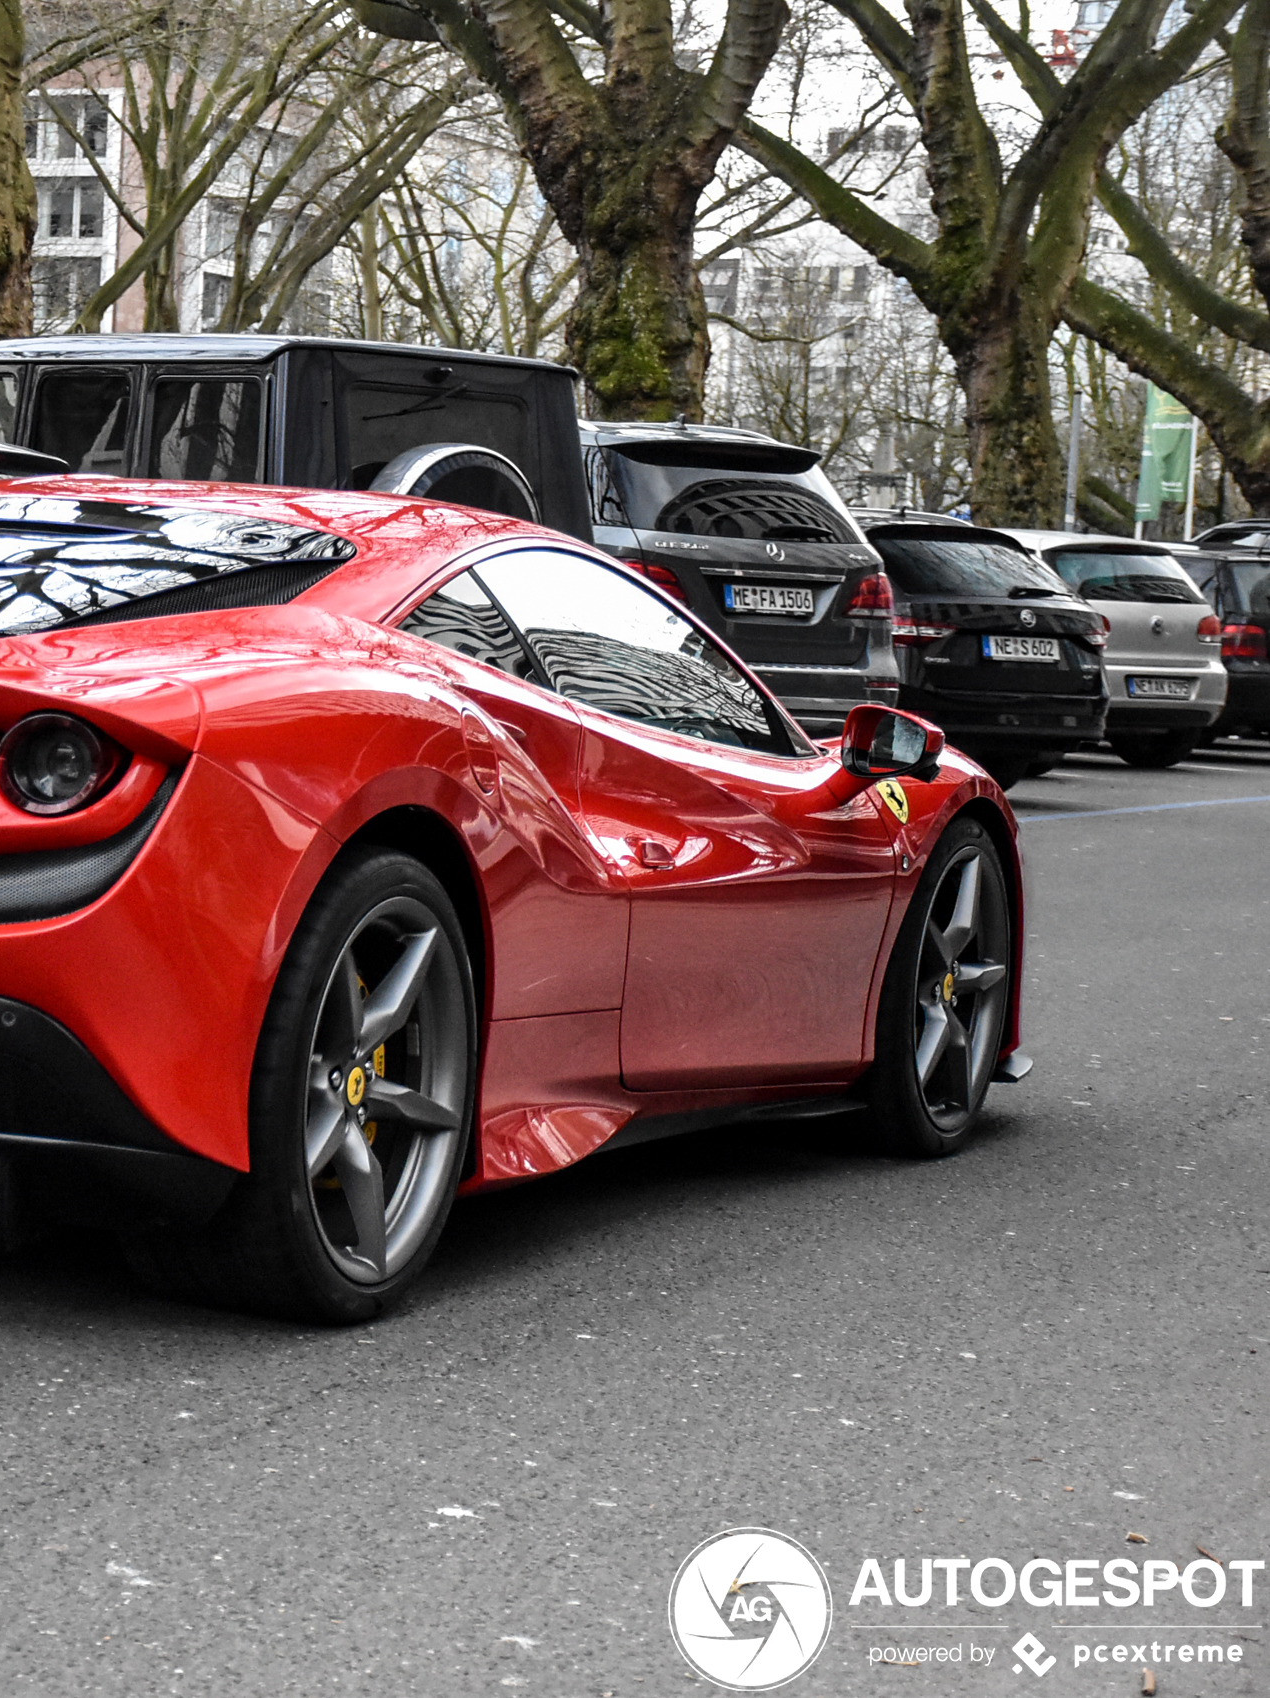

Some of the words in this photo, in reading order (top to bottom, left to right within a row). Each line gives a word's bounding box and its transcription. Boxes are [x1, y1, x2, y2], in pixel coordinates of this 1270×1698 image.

[734, 588, 750, 606] ME
[759, 590, 776, 607] FA
[779, 591, 810, 609] 1506
[995, 639, 1011, 654] NE
[1021, 640, 1029, 655] S
[1032, 641, 1054, 656] 602
